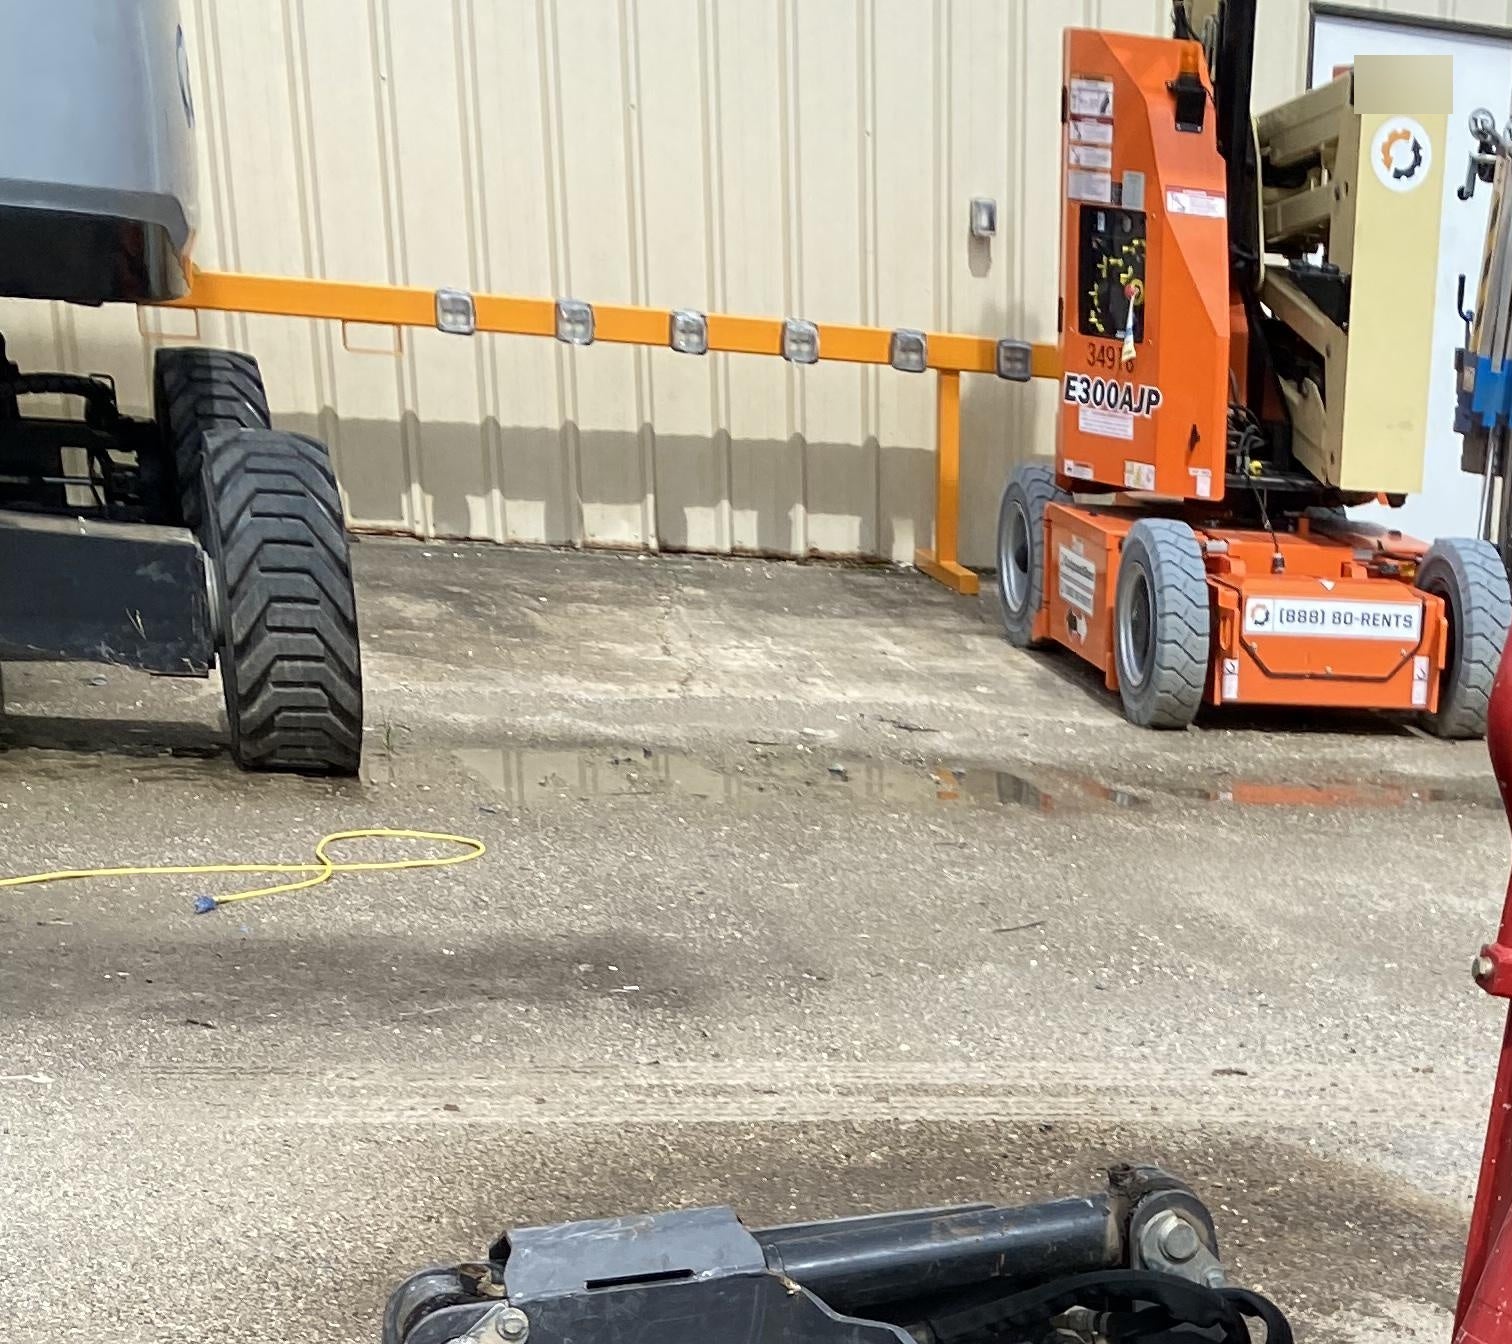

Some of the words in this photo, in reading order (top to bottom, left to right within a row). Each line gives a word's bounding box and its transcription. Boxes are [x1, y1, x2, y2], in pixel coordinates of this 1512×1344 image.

[1064, 372, 1162, 417] E300AJP
[1278, 607, 1325, 625] (888)
[1331, 611, 1414, 629] 80-RENTS
